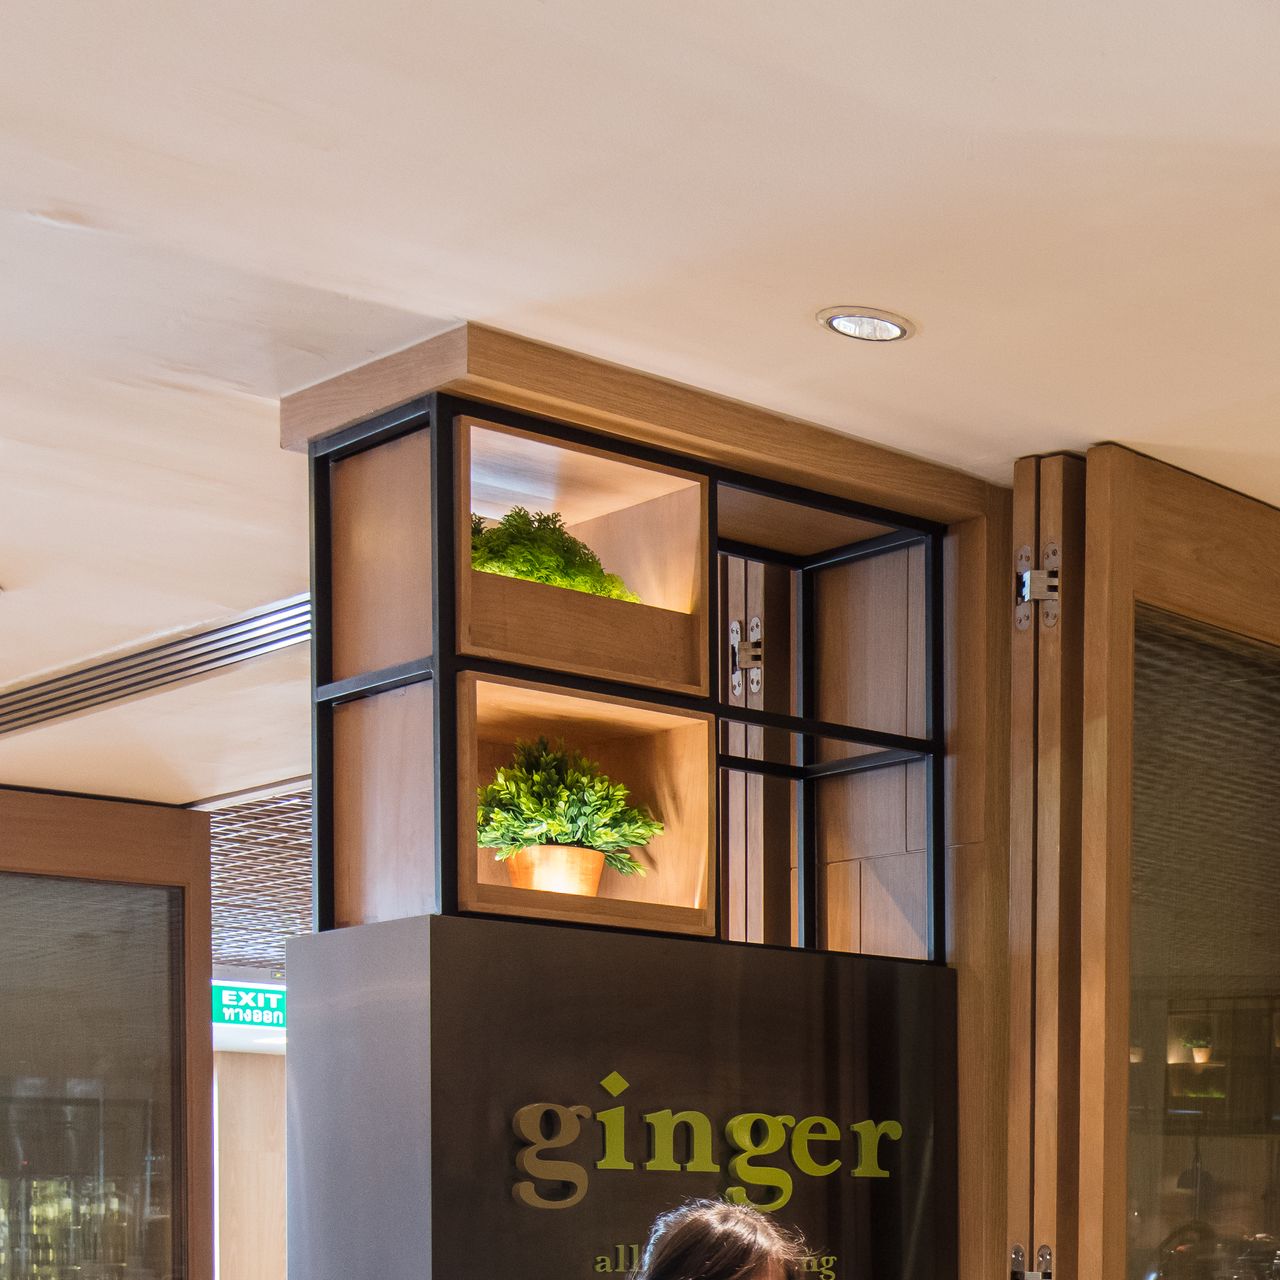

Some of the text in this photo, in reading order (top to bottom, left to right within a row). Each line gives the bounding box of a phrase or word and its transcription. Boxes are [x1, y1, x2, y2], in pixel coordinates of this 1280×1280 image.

[222, 989, 284, 1009] EXIT
[222, 1007, 284, 1025] ทางออก
[511, 1070, 903, 1213] ginger
[593, 1243, 641, 1273] all
